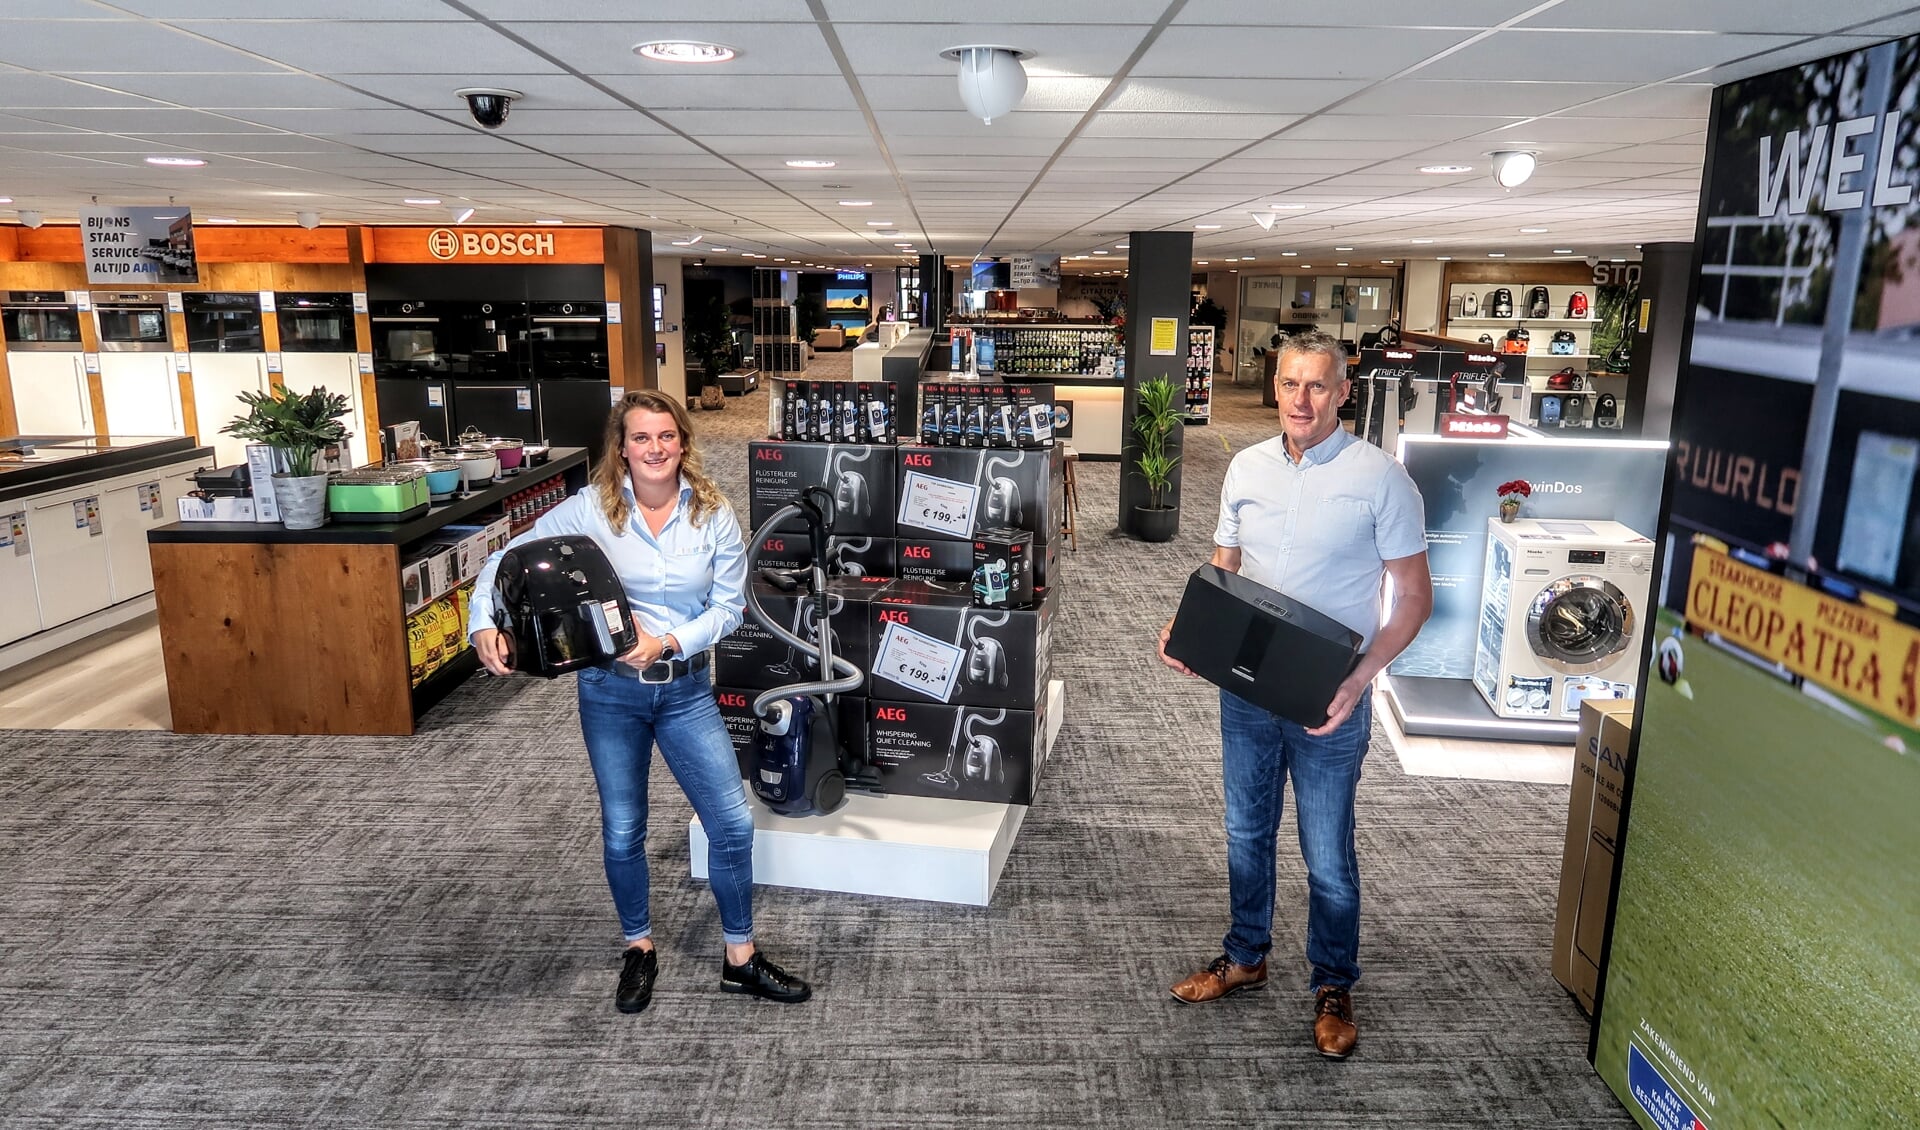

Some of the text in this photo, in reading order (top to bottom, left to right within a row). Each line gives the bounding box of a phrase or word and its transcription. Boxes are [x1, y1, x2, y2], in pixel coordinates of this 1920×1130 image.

[1758, 110, 1912, 217] WEL
[88, 217, 103, 229] BIJ
[90, 232, 126, 243] STAAT
[462, 232, 555, 256] BOSCH
[92, 247, 139, 258] SERVICE
[94, 263, 130, 275] ALTIJD
[1386, 351, 1413, 359] Miele
[1468, 354, 1497, 363] Miele
[926, 385, 938, 393] AEG
[969, 386, 981, 394] AEG
[1449, 421, 1502, 433] Miele
[755, 449, 783, 460] AEG
[904, 454, 932, 467] AEG
[755, 469, 798, 478] FLÜSTERLEISE
[755, 477, 788, 485] REINIGUNG
[916, 483, 928, 491] AEG
[1524, 480, 1583, 494] winDos
[923, 508, 931, 518] €
[932, 511, 957, 524] 199,-
[975, 542, 986, 550] AEG
[903, 546, 931, 559] AEG
[757, 559, 799, 568] FLÜSTERLEISE
[902, 566, 946, 576] FLÜSTERLEISE
[903, 574, 936, 582] REINIGUNG
[1708, 558, 1783, 602] STEAKHOUSE
[879, 610, 909, 623] AEG
[1816, 600, 1881, 643] PIZZERIA
[741, 631, 773, 639] CLEANING
[895, 635, 909, 645] AEG
[1693, 580, 1882, 700] CLEOPATRA
[899, 664, 908, 673] €
[909, 667, 935, 684] 199,-
[717, 693, 746, 707] AEG
[876, 707, 907, 721] AEG
[876, 729, 917, 739] WHISPERING
[876, 737, 932, 748] QUIET CLEANING
[1606, 780, 1616, 794] AIR
[1640, 1017, 1716, 1106] ZAKENVRIEND VAN
[1635, 1084, 1677, 1130] BESTRIJDIN
[1665, 1089, 1682, 1113] KWF
[1651, 1088, 1680, 1128] KANKER
